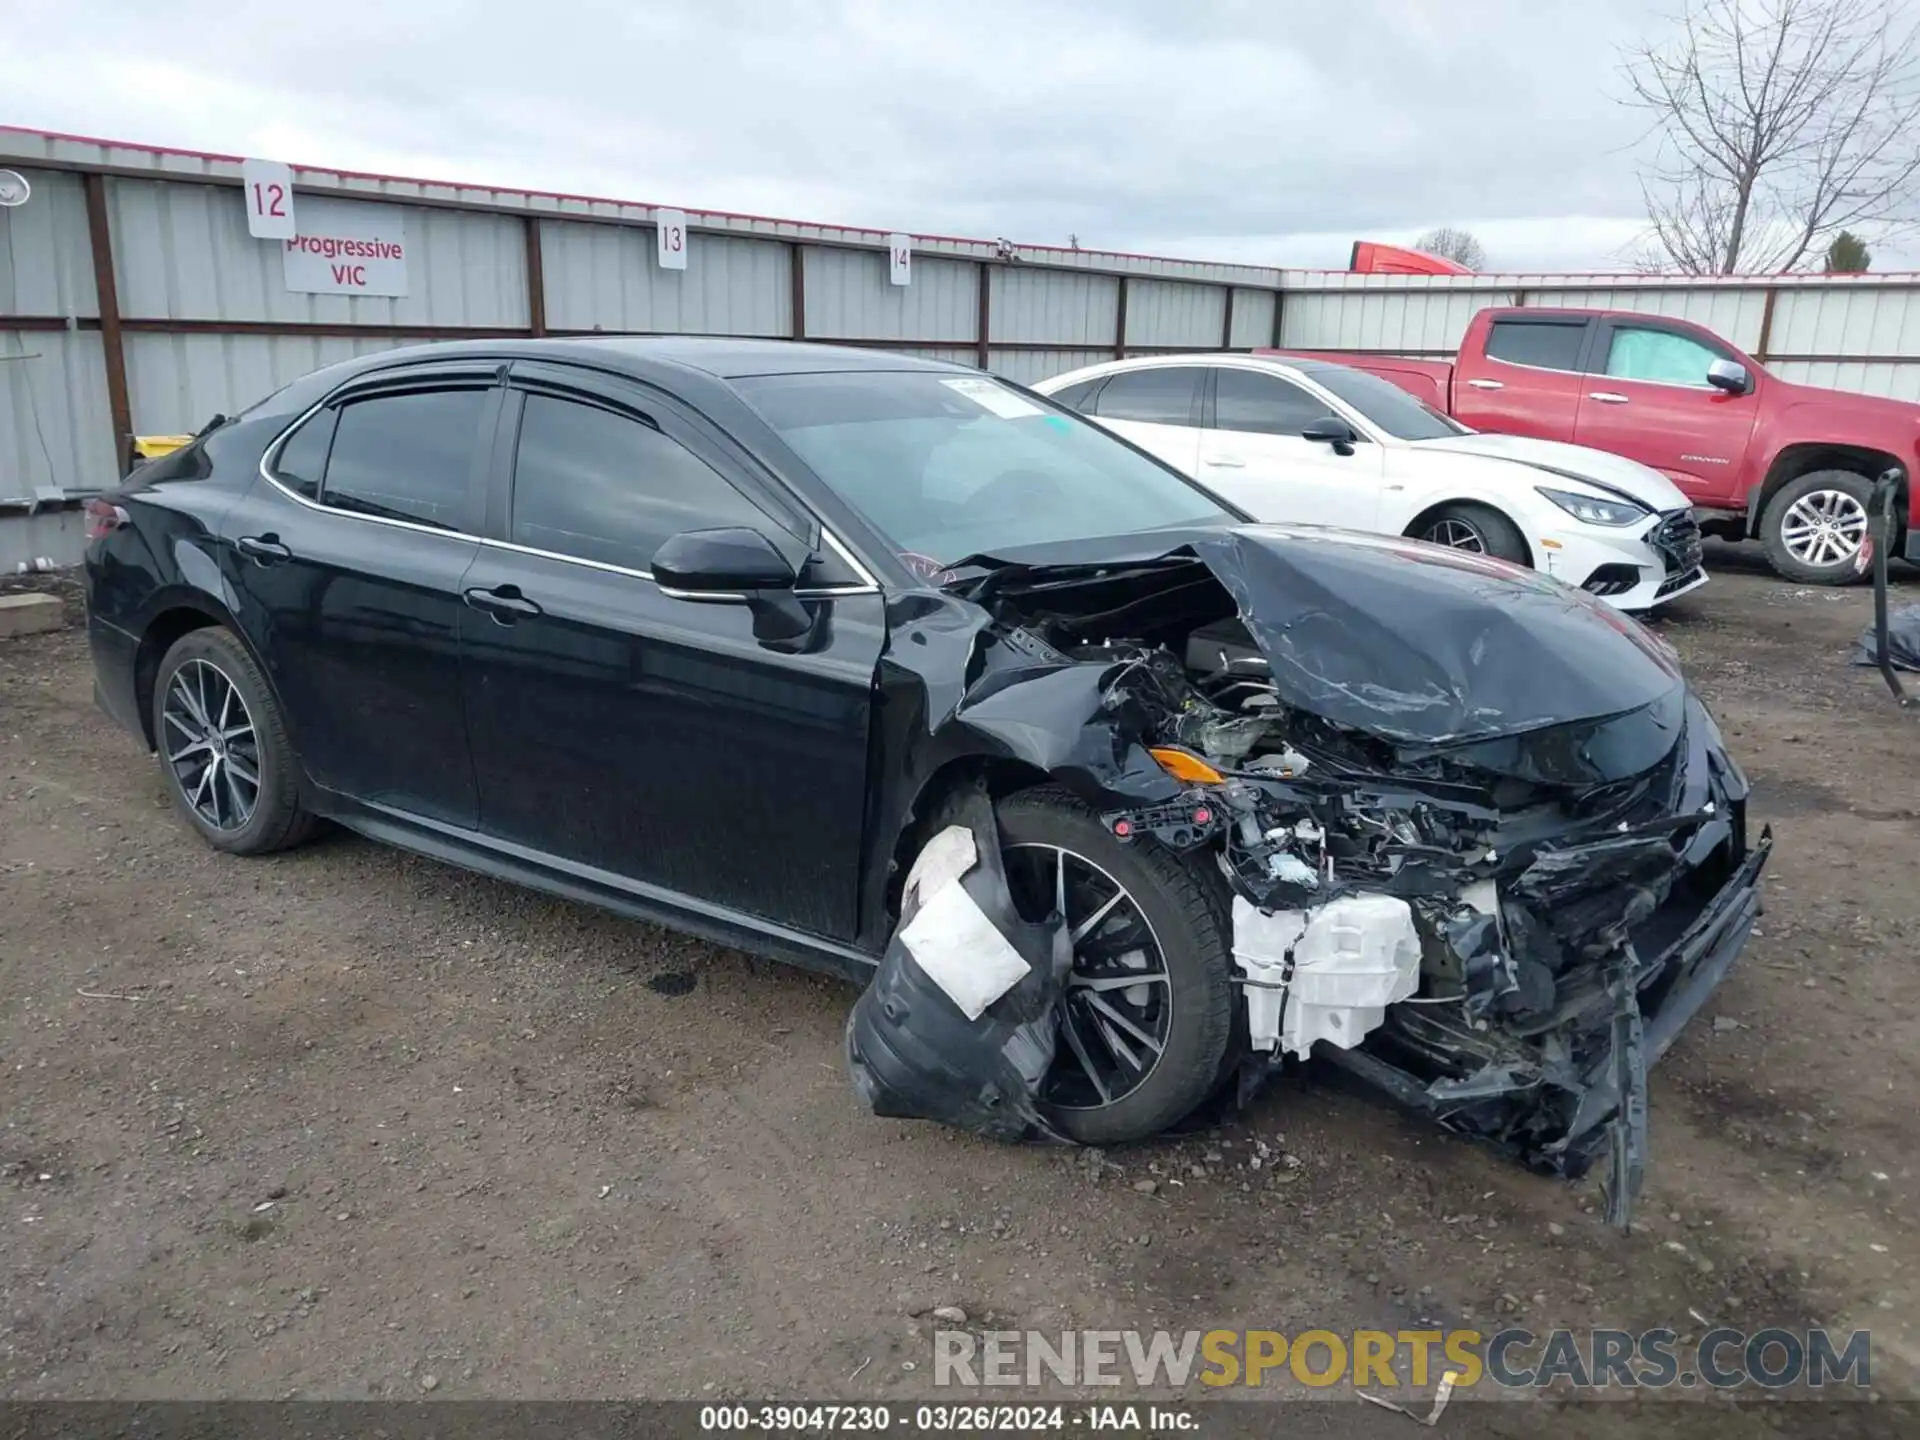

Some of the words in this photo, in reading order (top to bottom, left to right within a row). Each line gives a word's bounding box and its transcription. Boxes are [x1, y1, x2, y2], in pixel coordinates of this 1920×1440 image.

[253, 183, 285, 216] 12
[287, 234, 402, 260] Progressive
[663, 225, 681, 252] 13
[893, 247, 907, 271] 14
[332, 264, 366, 286] VIC
